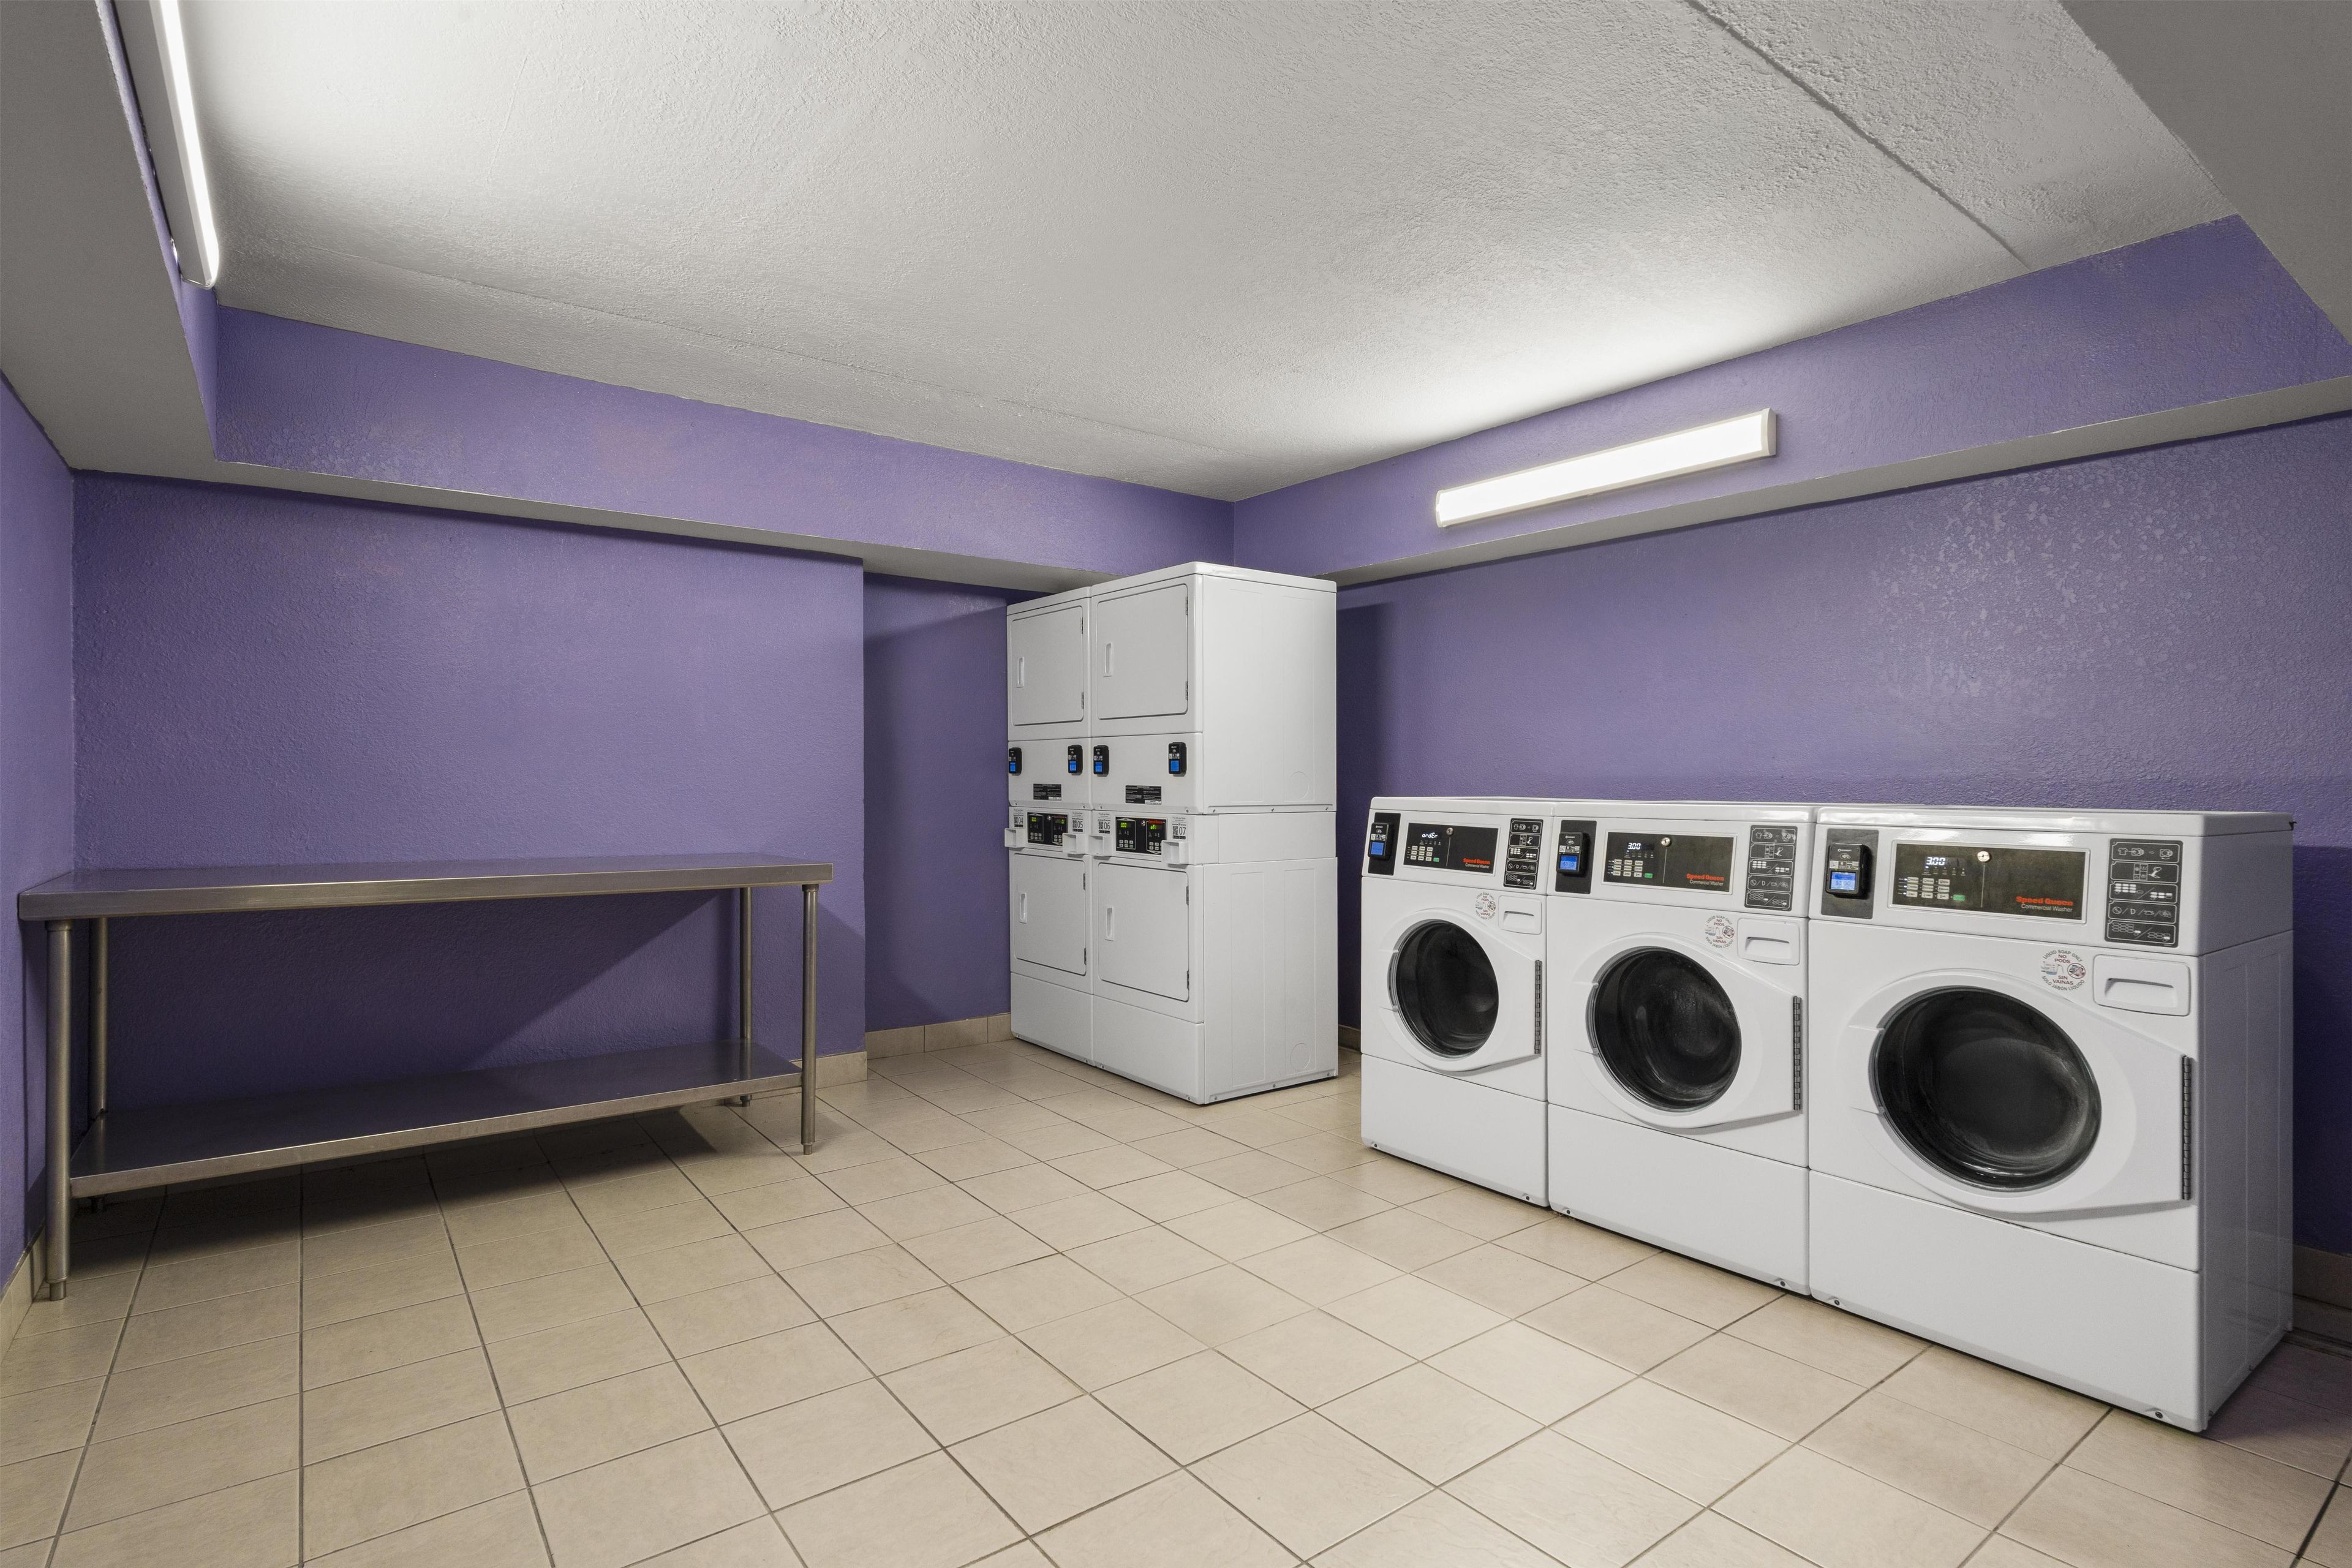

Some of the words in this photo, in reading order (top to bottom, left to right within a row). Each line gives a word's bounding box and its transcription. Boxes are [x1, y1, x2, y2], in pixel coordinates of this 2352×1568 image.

[1926, 856, 1946, 865] 3.00
[2043, 950, 2057, 959] LIQUID
[2071, 953, 2084, 962] ONLY
